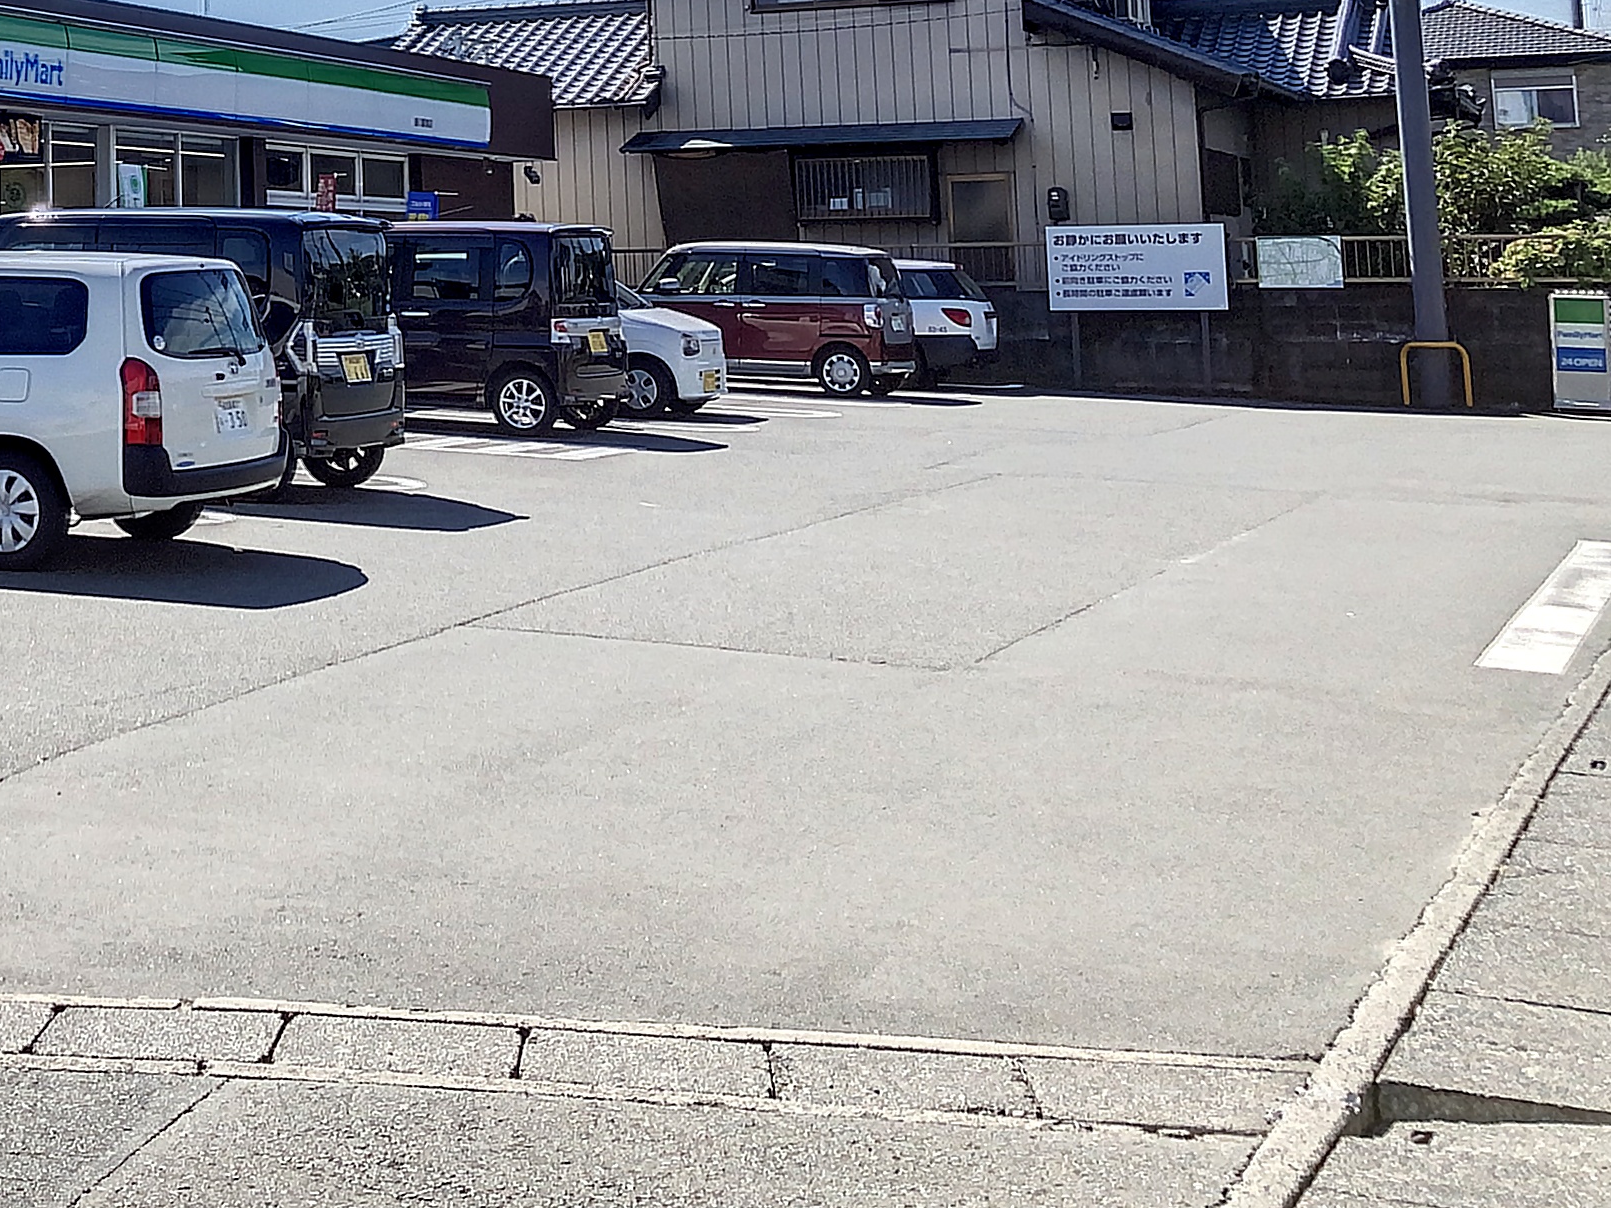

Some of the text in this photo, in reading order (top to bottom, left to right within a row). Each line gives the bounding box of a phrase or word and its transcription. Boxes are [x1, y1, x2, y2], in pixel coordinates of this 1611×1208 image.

[1053, 232, 1202, 246] お静かにお願いいたします
